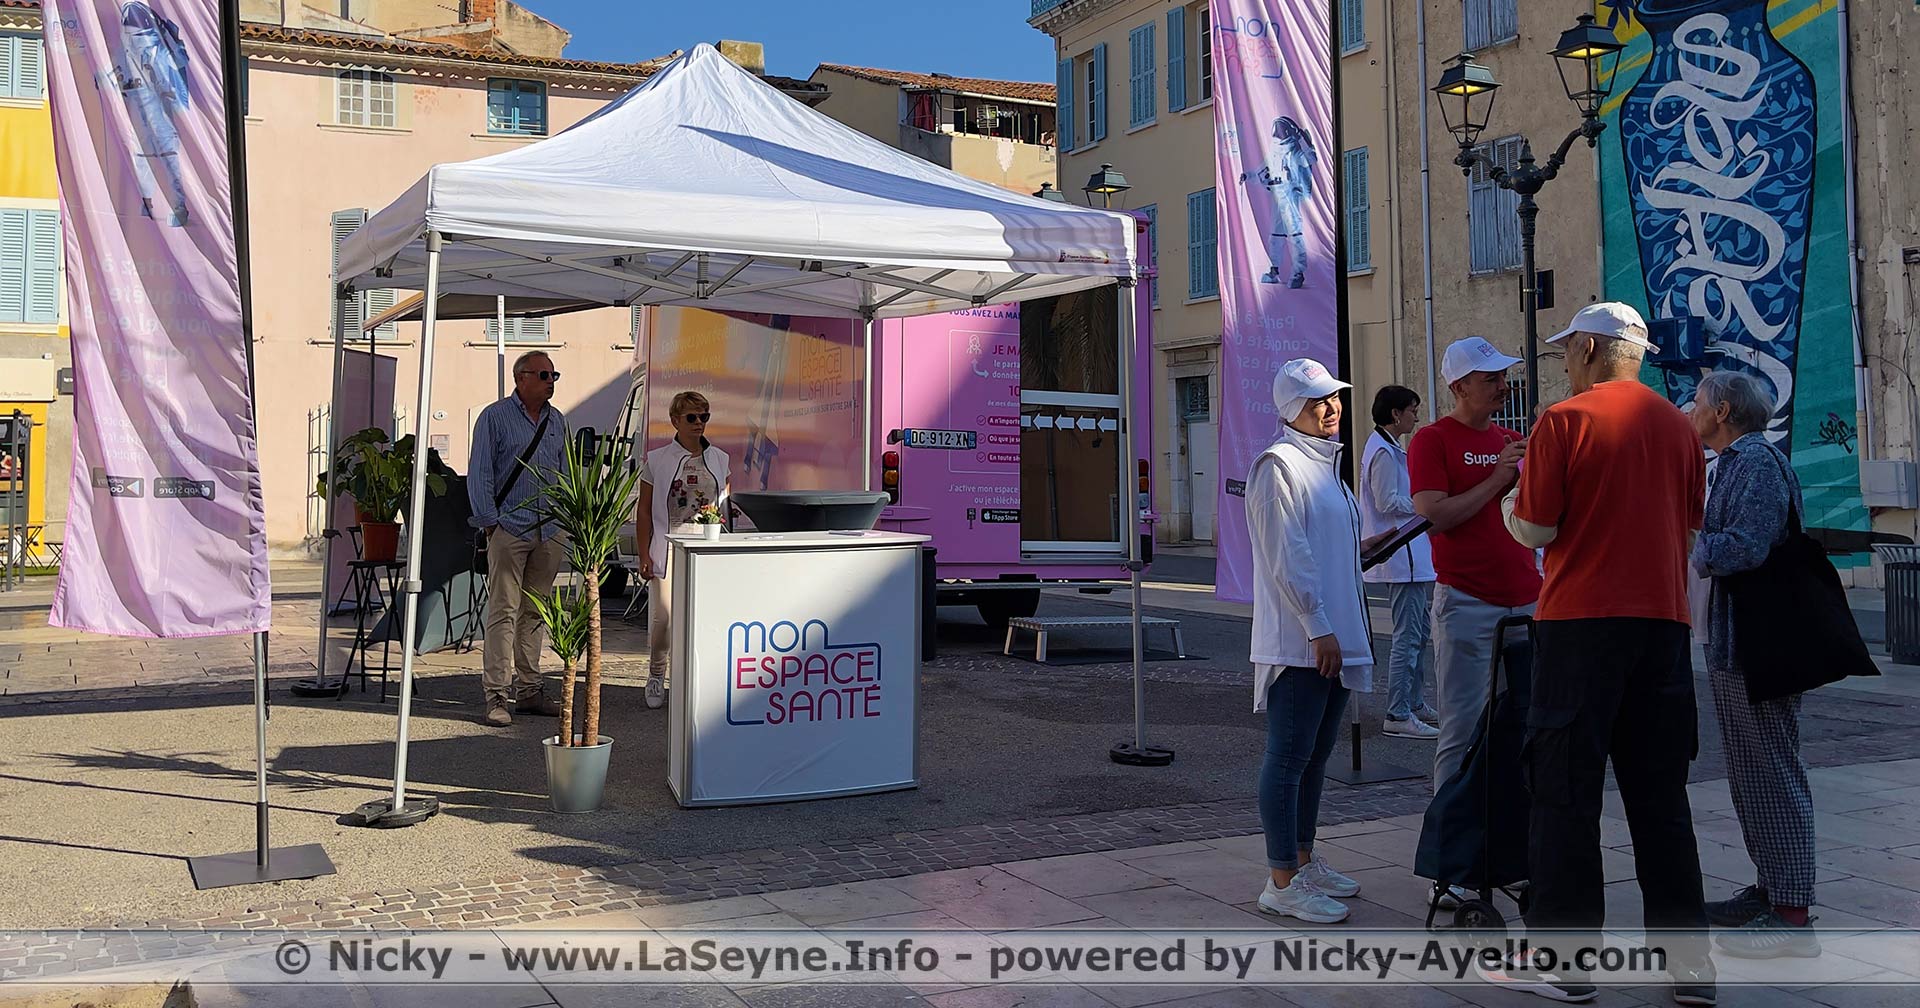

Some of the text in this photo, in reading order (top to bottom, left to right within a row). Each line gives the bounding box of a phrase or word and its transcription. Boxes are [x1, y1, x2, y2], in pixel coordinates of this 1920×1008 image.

[972, 309, 991, 317] AVEZ
[992, 345, 1004, 355] JE
[802, 352, 840, 379] ESPACE
[995, 486, 1018, 494] espace
[736, 651, 874, 689] ESPACE
[766, 684, 880, 725] SANTÉ
